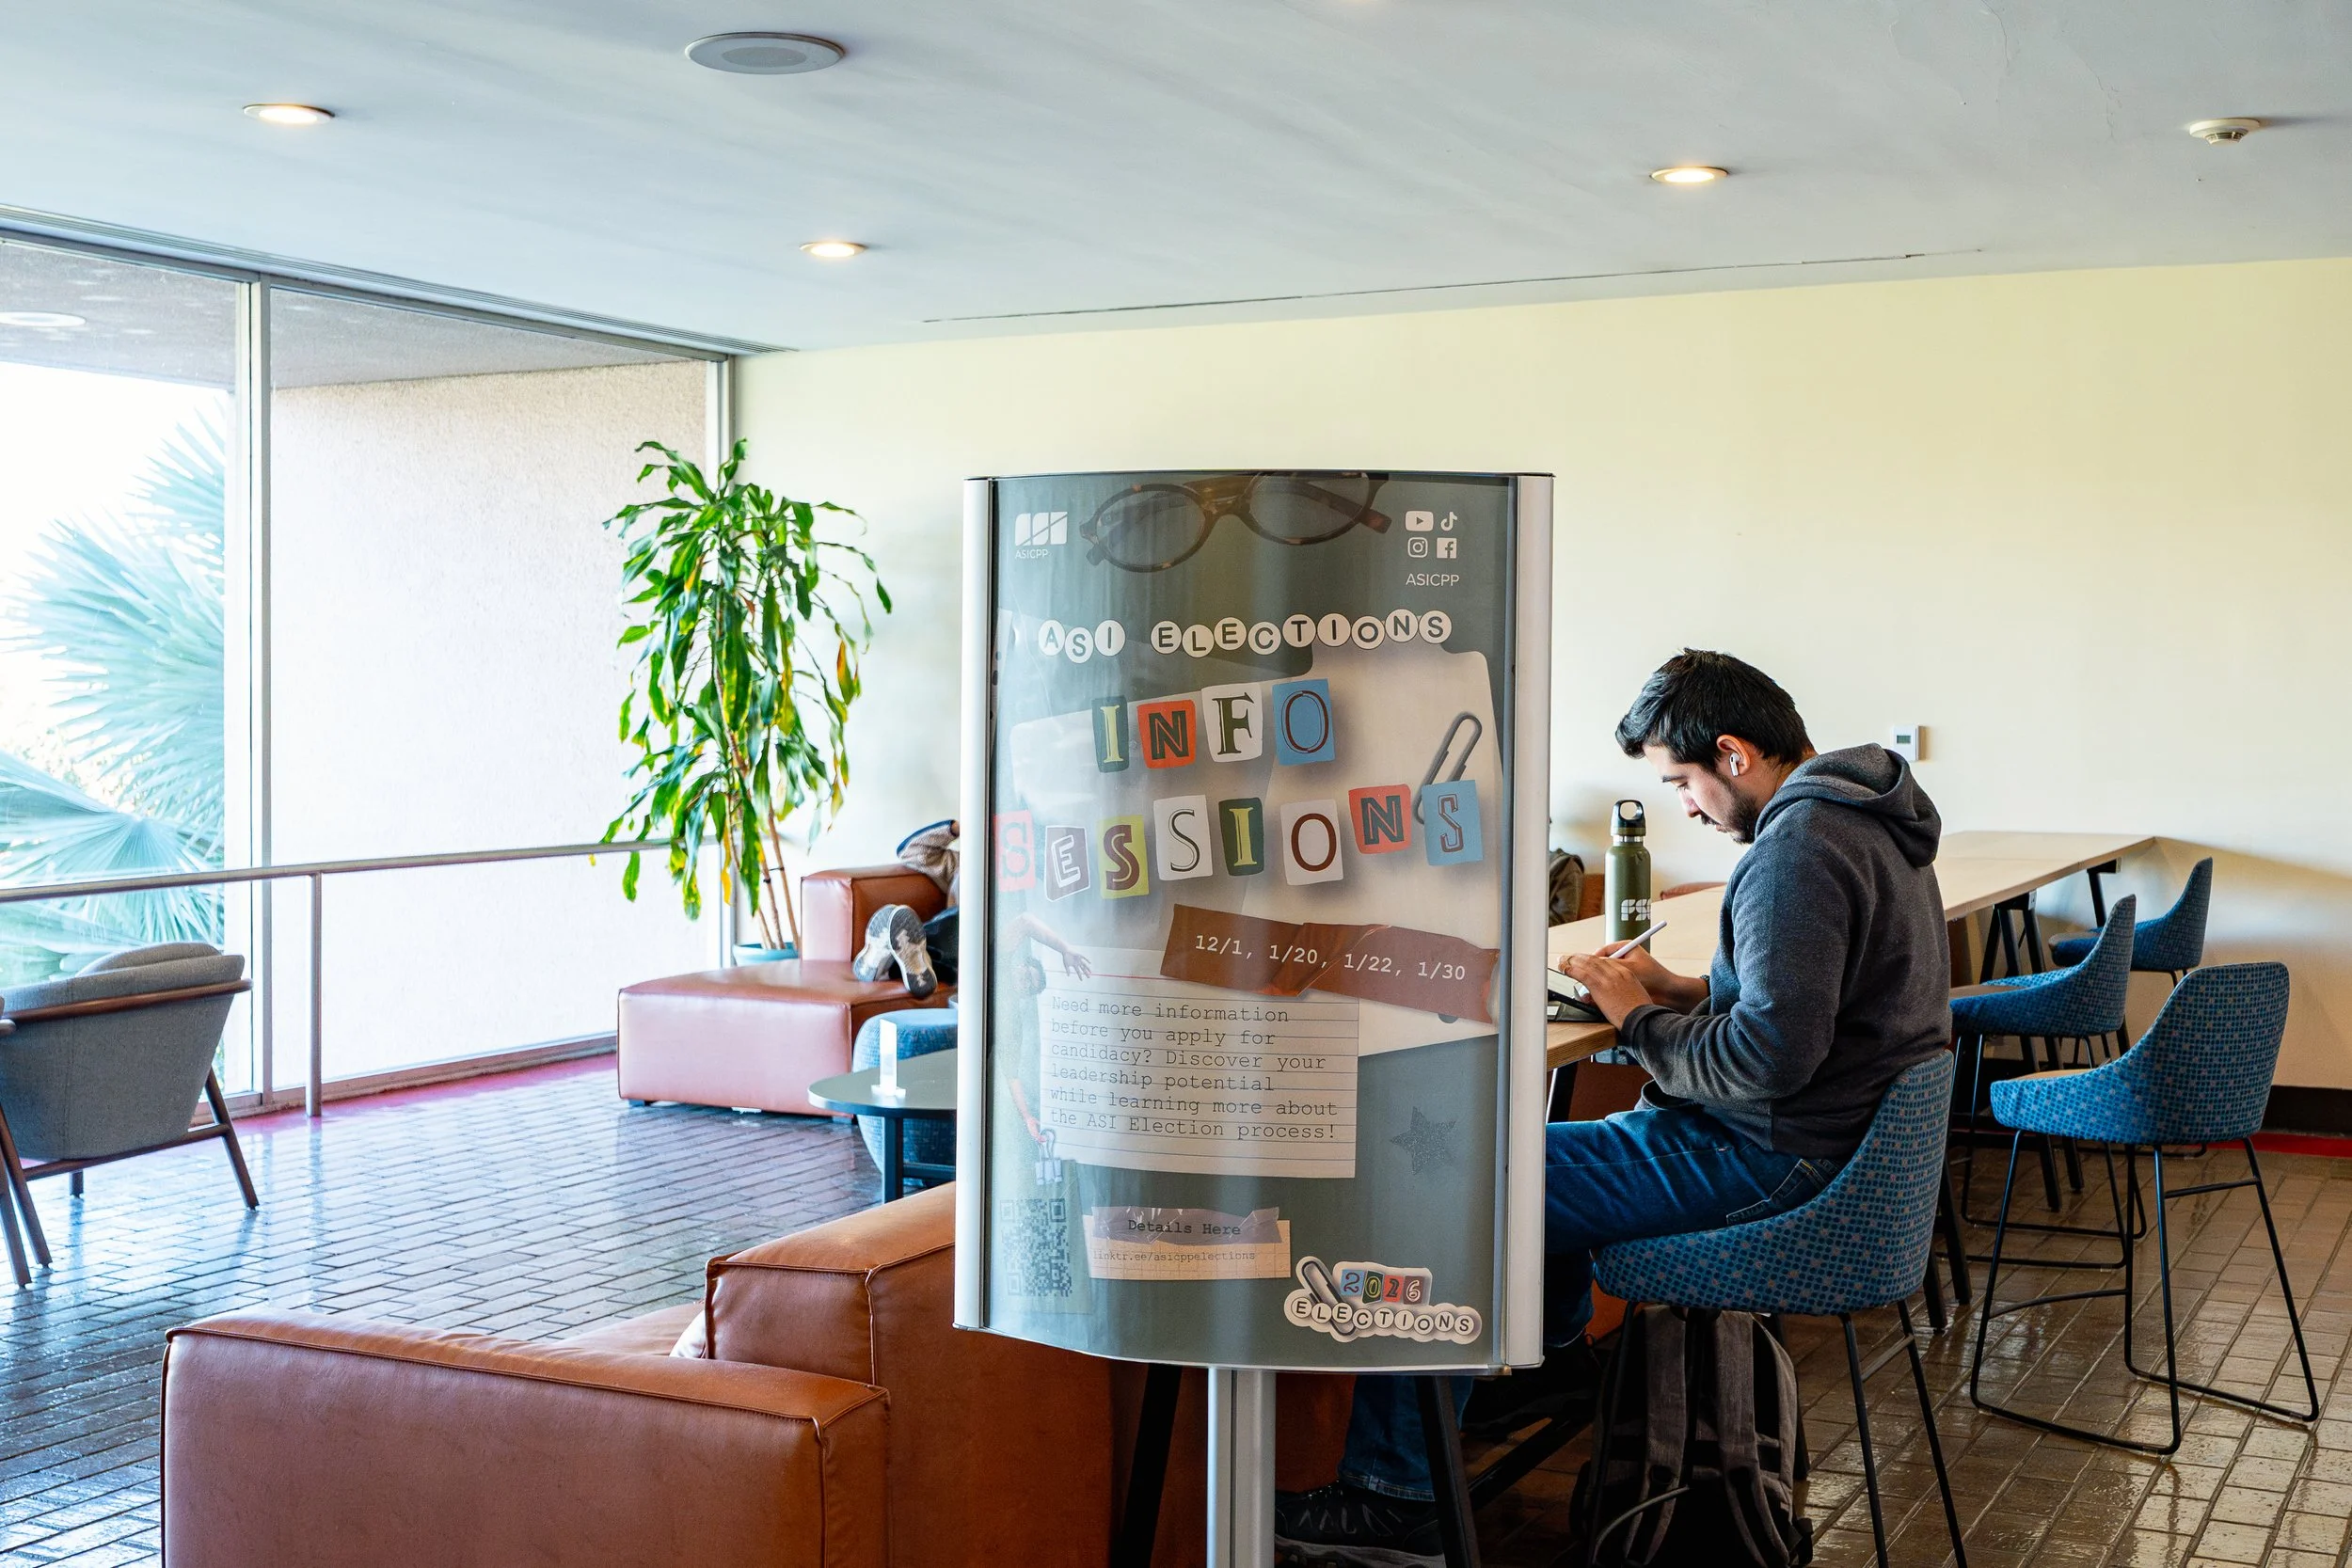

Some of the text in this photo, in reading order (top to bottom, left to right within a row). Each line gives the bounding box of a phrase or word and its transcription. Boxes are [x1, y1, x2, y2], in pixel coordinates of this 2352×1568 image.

[1015, 548, 1049, 560] ASICPP
[1406, 573, 1460, 586] ASICPP
[1043, 614, 1445, 658] ASI ELECTIONS
[1100, 688, 1331, 764] INFO
[1001, 793, 1465, 891] SESSIONS
[1195, 934, 1466, 981] 12/1, 1/20, 1/22, 1/30
[1052, 996, 1289, 1022] Need more information
[1051, 1019, 1276, 1047] before you apply for
[1051, 1043, 1327, 1072] candidacy? Discover your
[1051, 1063, 1275, 1091] leadership potential
[1050, 1086, 1339, 1116] while learning more about
[1051, 1109, 1335, 1141] the ASI Election process!
[1128, 1219, 1241, 1235] Details Here
[1093, 1250, 1255, 1262] linktr.ee/asicppelections
[1343, 1271, 1422, 1303] 2026
[1295, 1300, 1470, 1332] ELECTIONS
